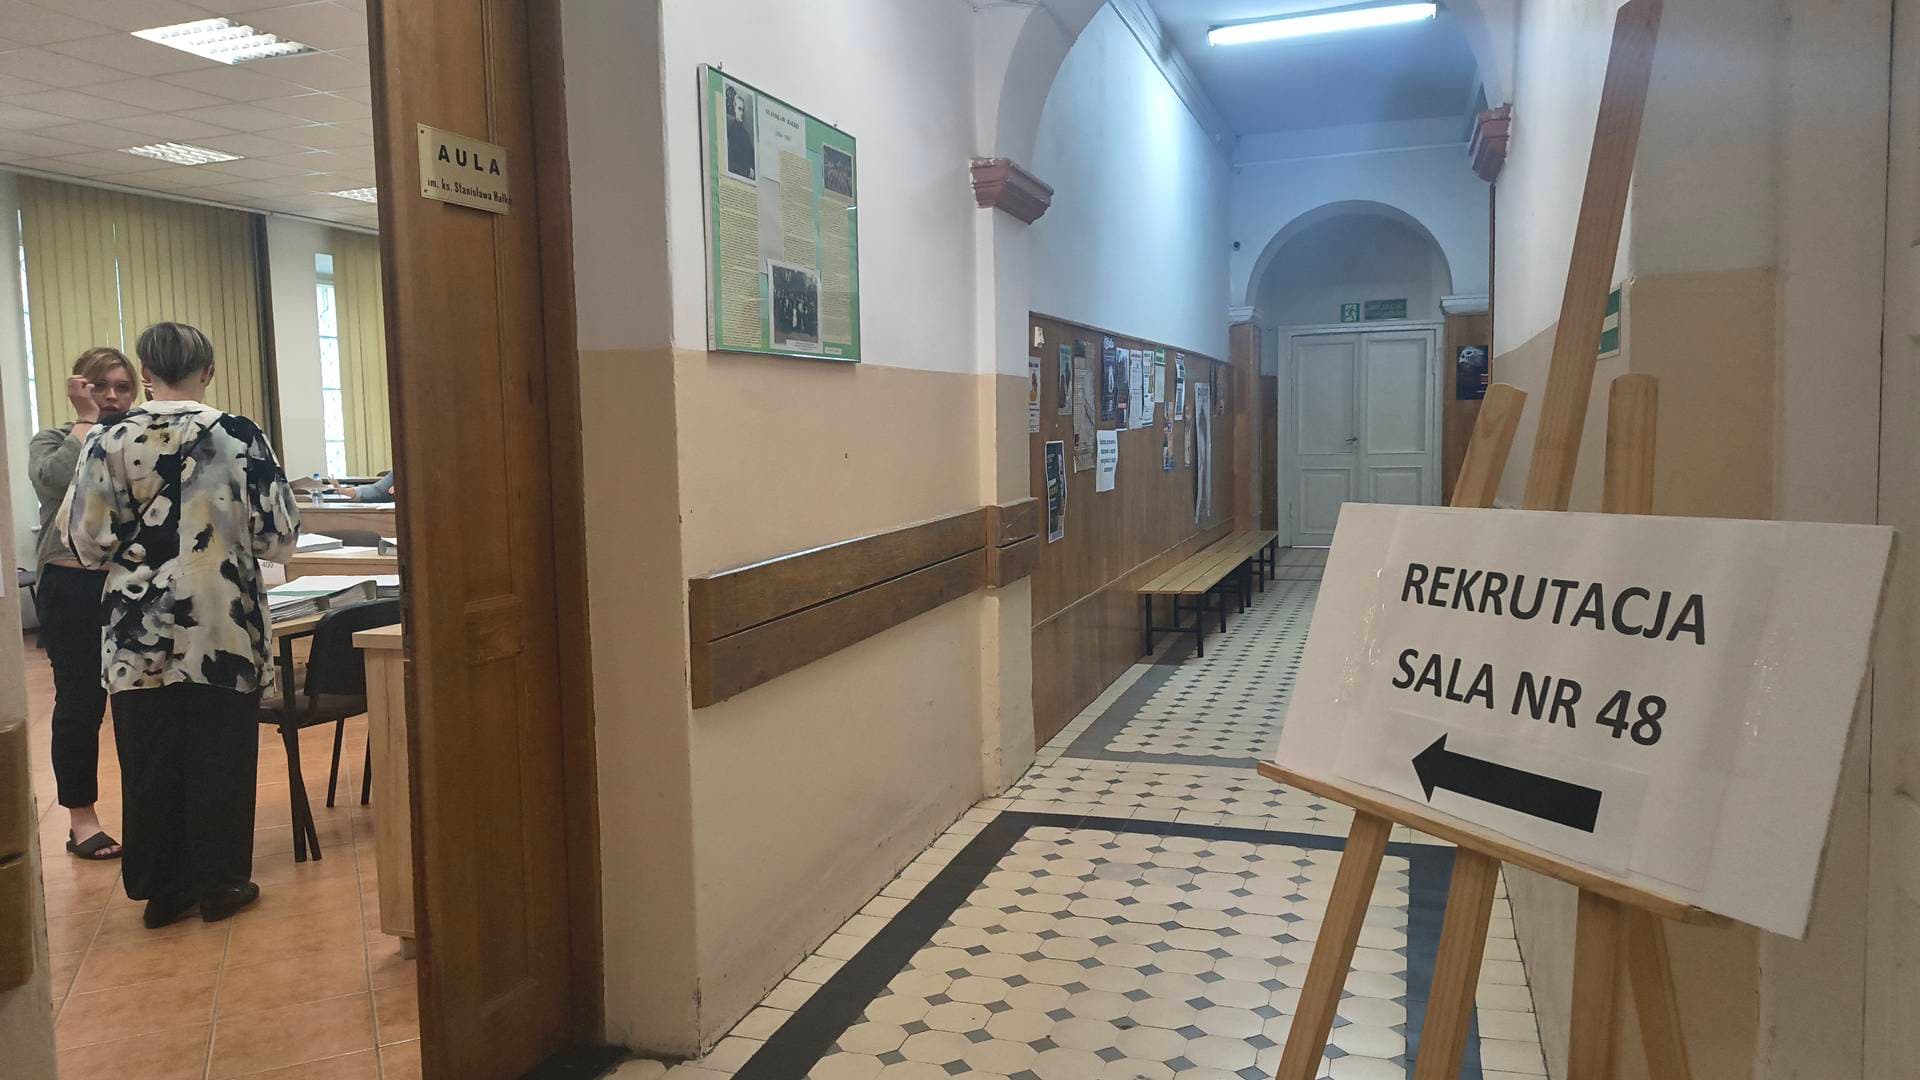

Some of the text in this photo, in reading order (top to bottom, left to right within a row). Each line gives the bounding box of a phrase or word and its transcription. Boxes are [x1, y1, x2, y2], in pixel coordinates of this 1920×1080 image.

[427, 178, 439, 188] im.
[441, 178, 453, 192] ks.
[438, 144, 500, 176] AULA
[1401, 563, 1706, 645] REKRUTACJA
[1392, 648, 1667, 746] SALA NR 48
